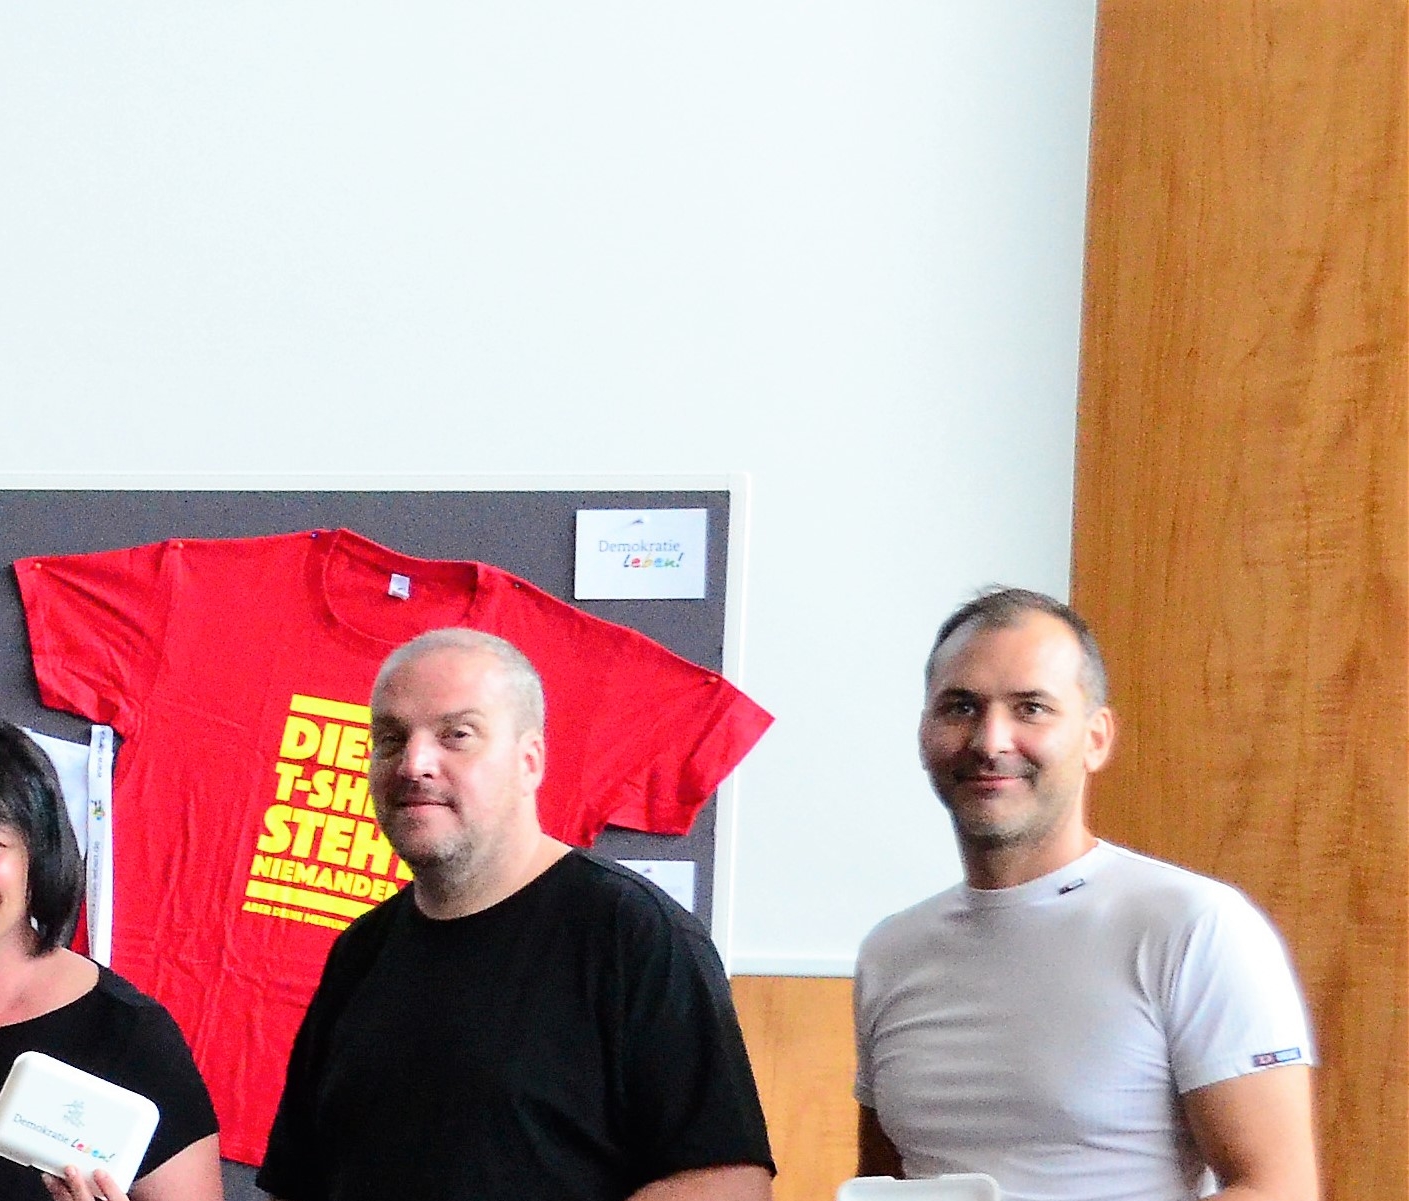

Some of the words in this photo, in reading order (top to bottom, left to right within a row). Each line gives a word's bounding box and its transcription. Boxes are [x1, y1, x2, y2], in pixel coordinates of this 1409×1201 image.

[598, 539, 680, 552] Demokratie
[623, 552, 684, 568] leben!
[279, 715, 373, 773] DIE
[257, 804, 415, 882] STEH
[13, 1113, 69, 1144] Demokratie
[70, 1138, 116, 1162] leben!
